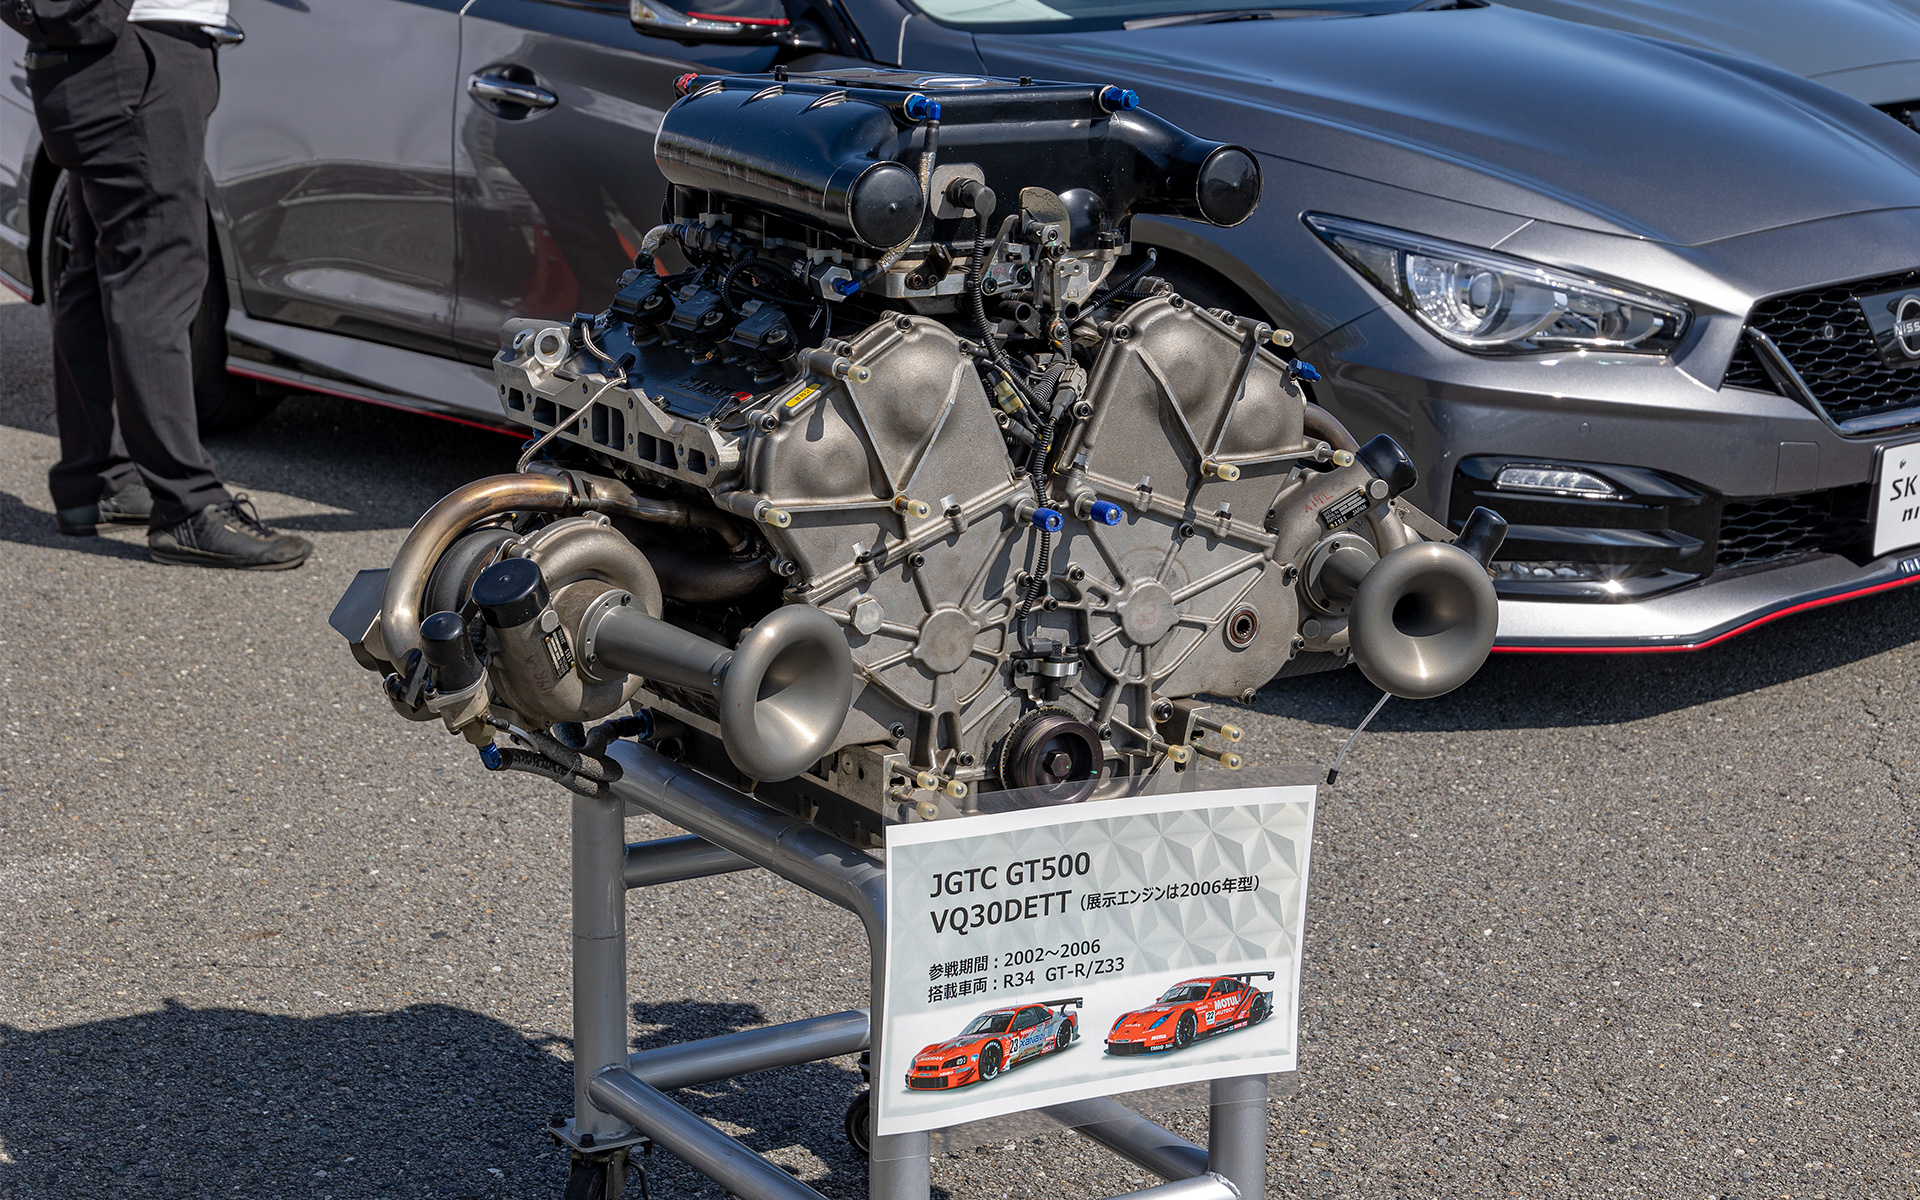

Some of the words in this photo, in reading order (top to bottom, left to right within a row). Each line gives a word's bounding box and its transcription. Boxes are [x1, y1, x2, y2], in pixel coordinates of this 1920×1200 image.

[930, 865, 998, 898] JGTC
[1005, 851, 1091, 886] GT500
[930, 889, 1073, 936] VQ30DETT
[1045, 956, 1125, 982] GT-R/Z33
[1214, 995, 1240, 1011] MOTUL
[1206, 1011, 1215, 1021] 22
[1010, 1038, 1019, 1054] 23
